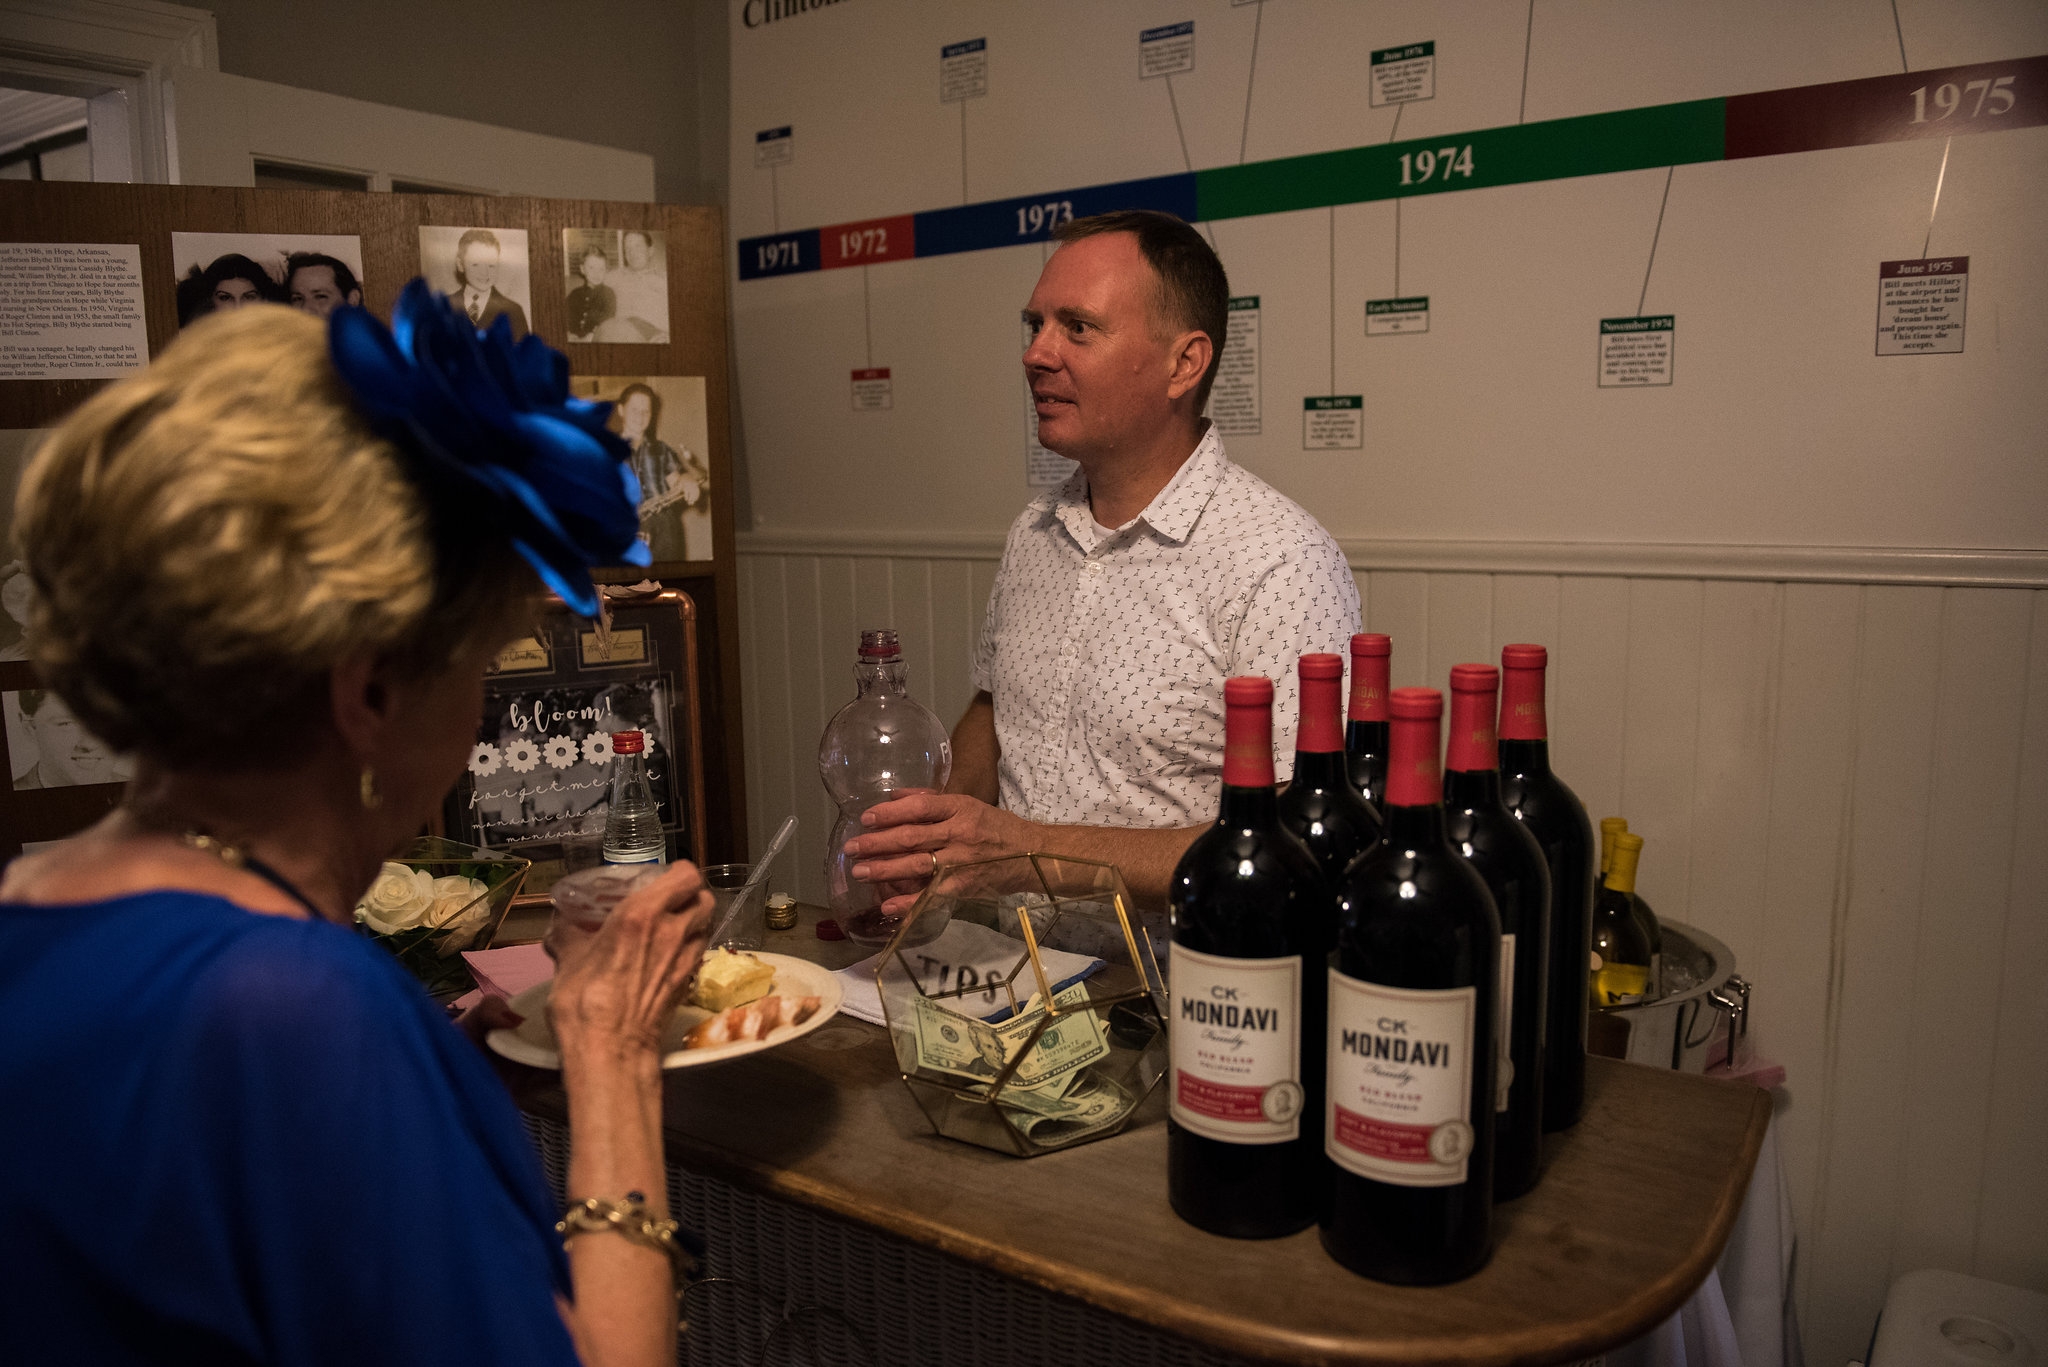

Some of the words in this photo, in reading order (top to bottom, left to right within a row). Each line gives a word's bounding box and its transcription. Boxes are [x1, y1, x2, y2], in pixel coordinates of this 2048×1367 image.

[743, 0, 842, 28] Clin
[1909, 76, 2017, 124] 1975
[757, 240, 801, 271] 1971
[839, 228, 889, 259] 1972
[1016, 200, 1075, 236] 1973
[1399, 144, 1475, 186] 1974
[1897, 264, 1925, 275] June
[1927, 261, 1954, 273] 1975
[1885, 281, 1900, 289] Bill
[1902, 280, 1927, 288] meets
[1929, 278, 1961, 287] Hillary
[1895, 289, 1908, 297] the
[1910, 288, 1942, 297] airport
[1886, 298, 1930, 306] announces
[1944, 295, 1959, 303] has
[1898, 306, 1928, 315] bought
[1930, 305, 1945, 313] her
[1603, 320, 1649, 332] November
[1651, 318, 1672, 329] 1974
[1897, 324, 1934, 333] proposes
[1936, 322, 1962, 331] again.
[1893, 333, 1911, 341] This
[1913, 332, 1933, 340] time
[1934, 331, 1948, 339] she
[1903, 341, 1936, 350] accepts.
[510, 696, 612, 733] bloom!
[917, 954, 1003, 1005] TIPS
[1211, 984, 1239, 1001] CK
[1181, 996, 1278, 1033] MONDAVI
[1377, 1017, 1408, 1034] CK
[1341, 1029, 1449, 1069] MONDAVI
